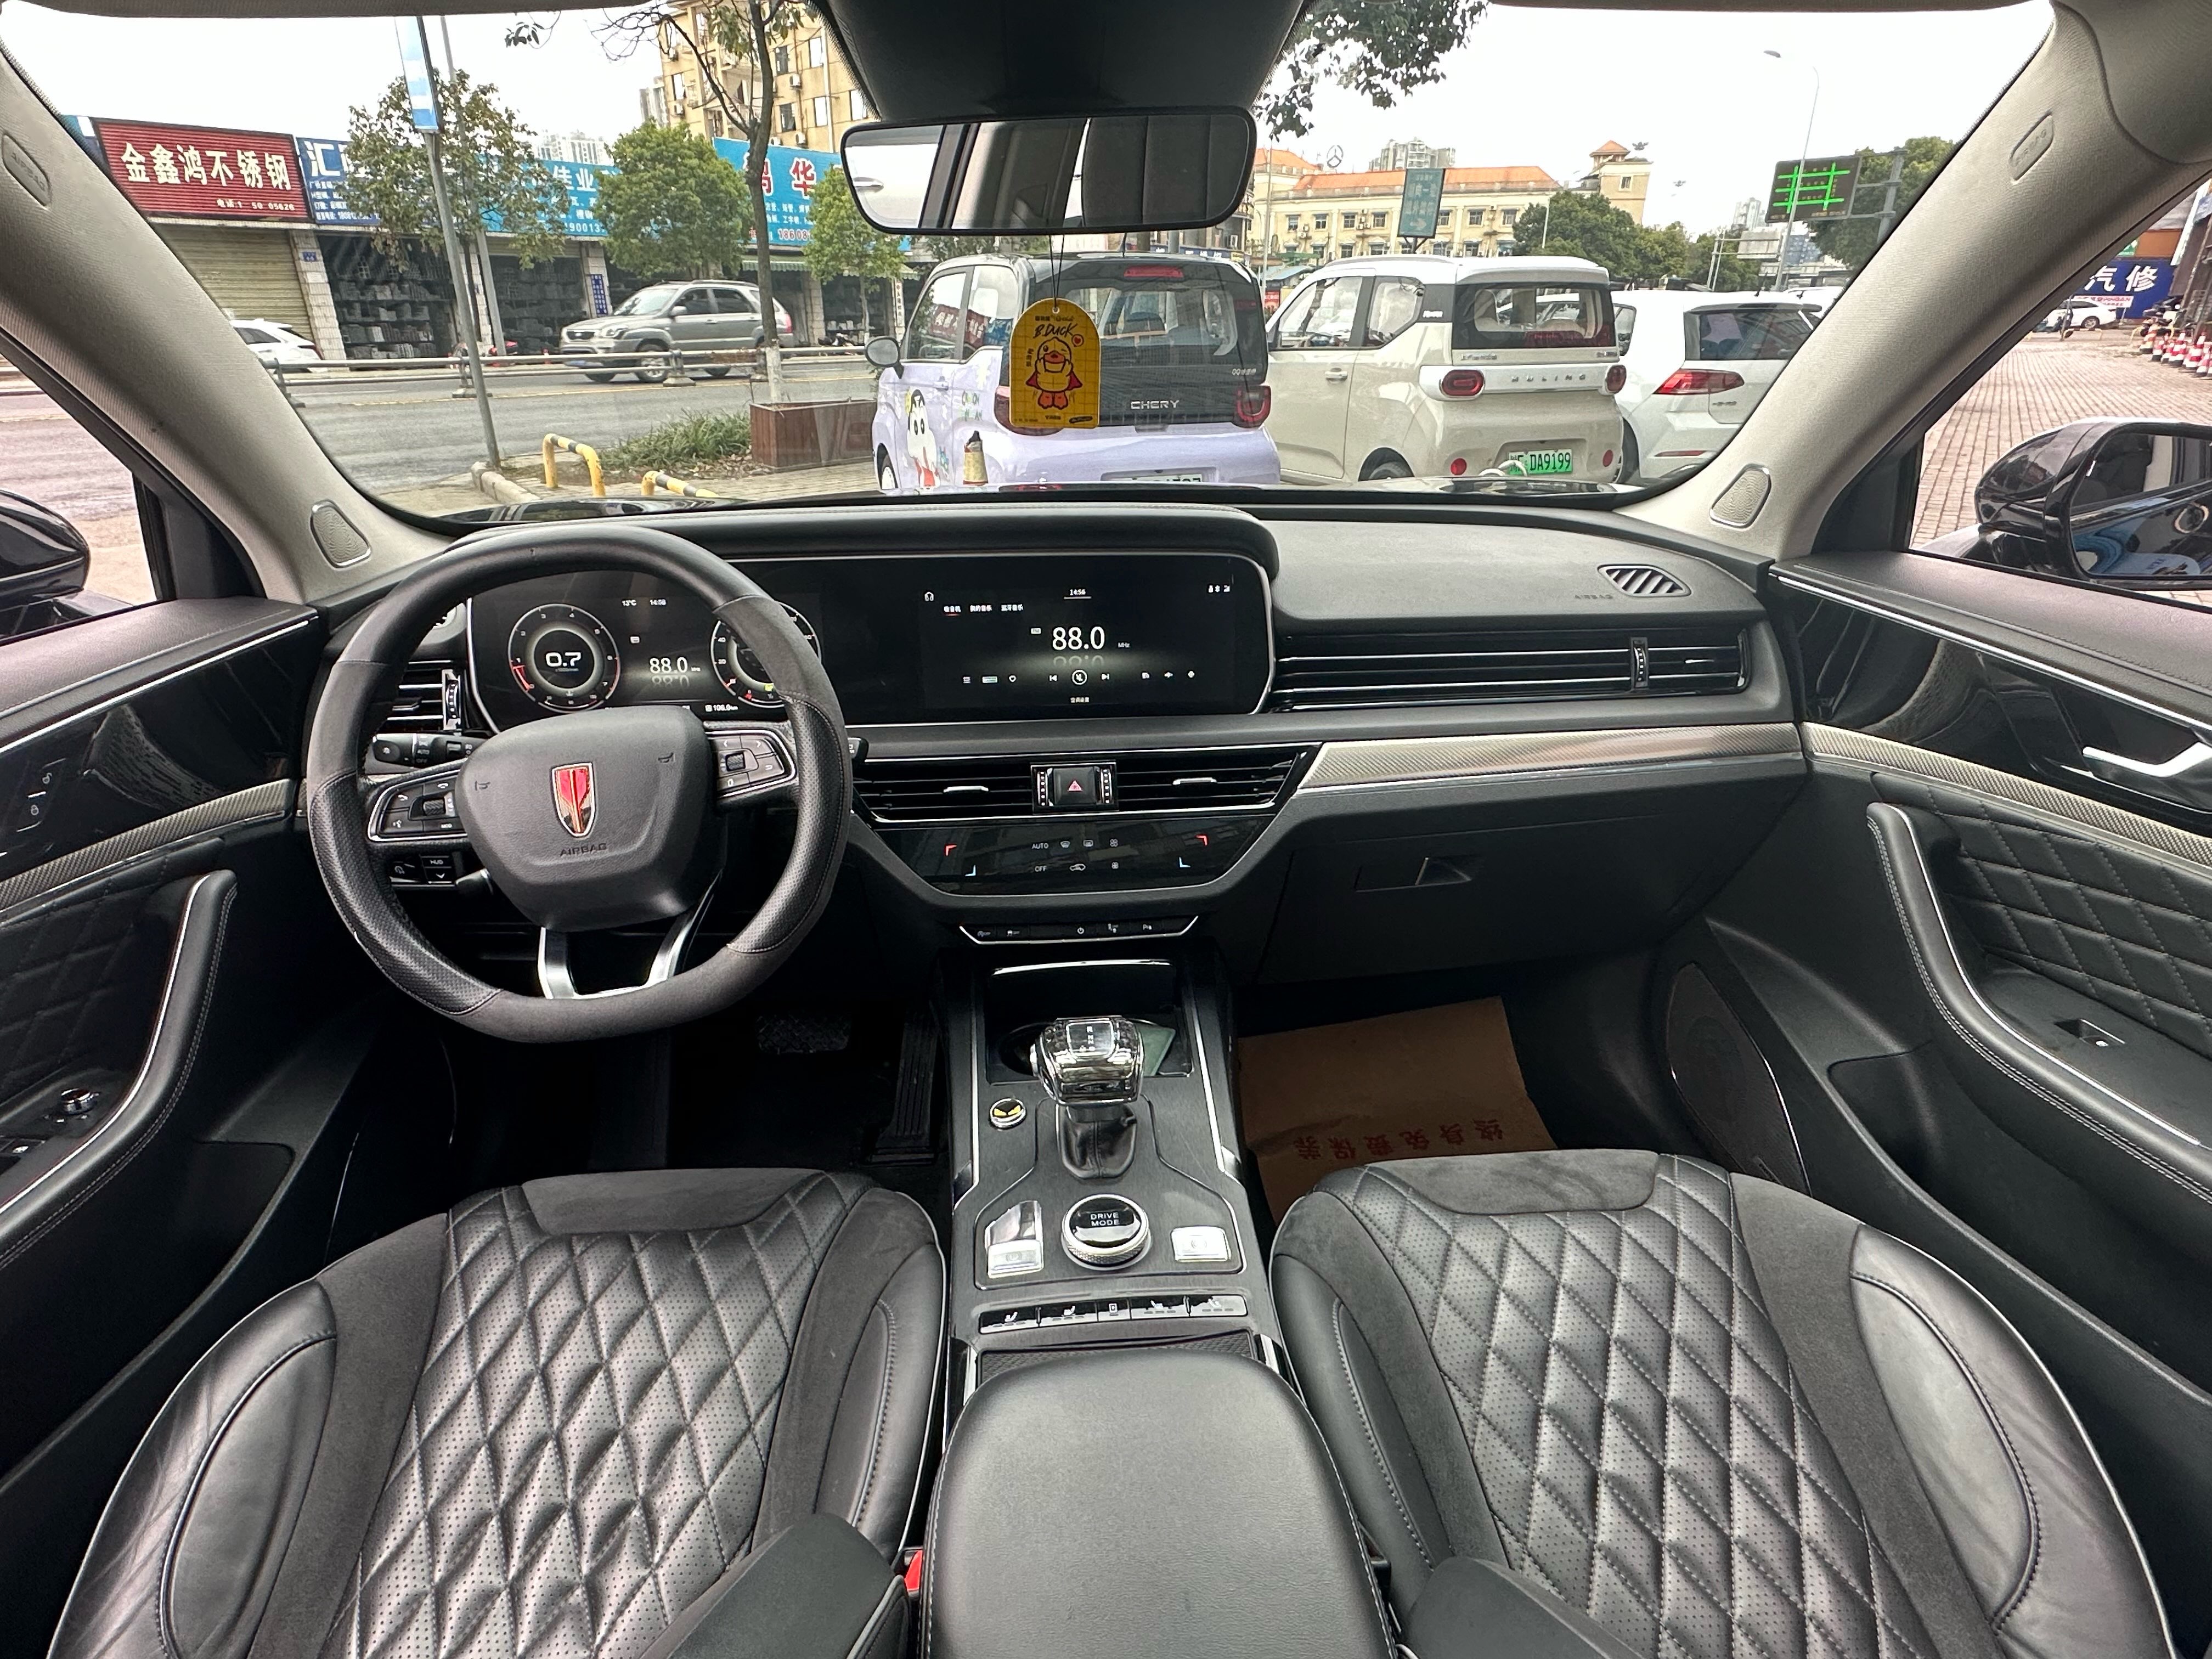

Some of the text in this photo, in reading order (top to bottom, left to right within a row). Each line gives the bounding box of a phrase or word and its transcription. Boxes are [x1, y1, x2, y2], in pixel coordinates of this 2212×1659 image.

[121, 142, 292, 191] 金鑫鸿不锈钢
[2084, 265, 2158, 292] 汽修
[1130, 400, 1180, 409] CHERY
[1052, 626, 1105, 651] 88.0
[545, 652, 582, 668] 0.7
[649, 656, 688, 674] 88.0
[560, 843, 607, 856] AIRBAG
[1293, 1118, 1504, 1160] 终身免费保养
